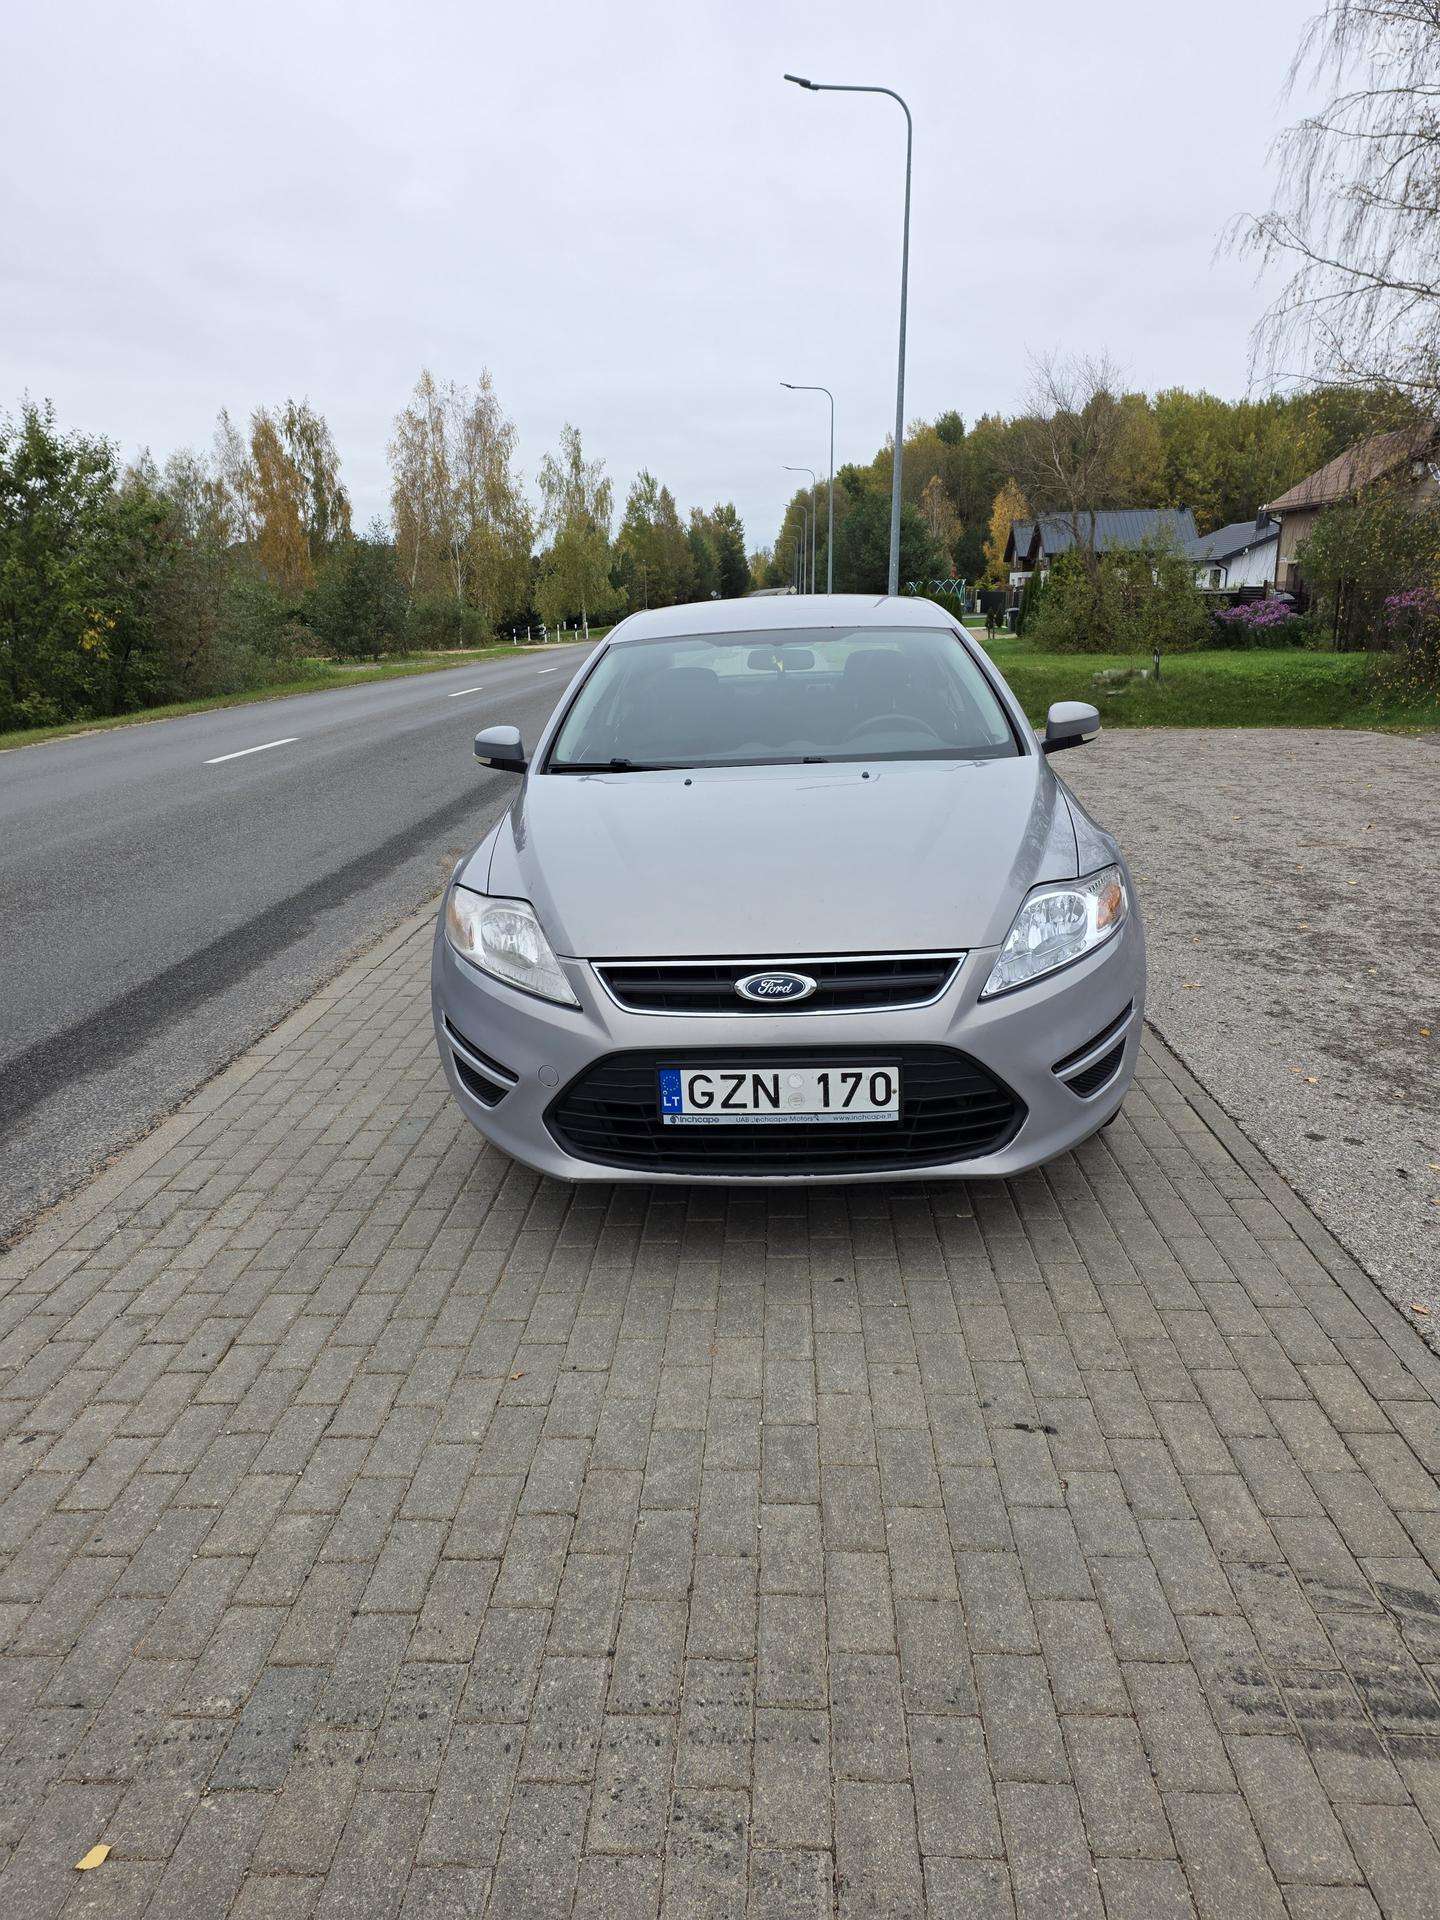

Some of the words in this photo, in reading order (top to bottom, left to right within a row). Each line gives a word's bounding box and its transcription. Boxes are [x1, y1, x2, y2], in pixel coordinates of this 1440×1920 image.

[757, 979, 793, 995] Ford
[688, 1074, 781, 1109] GZN
[817, 1072, 892, 1108] 170
[663, 1096, 680, 1107] LT
